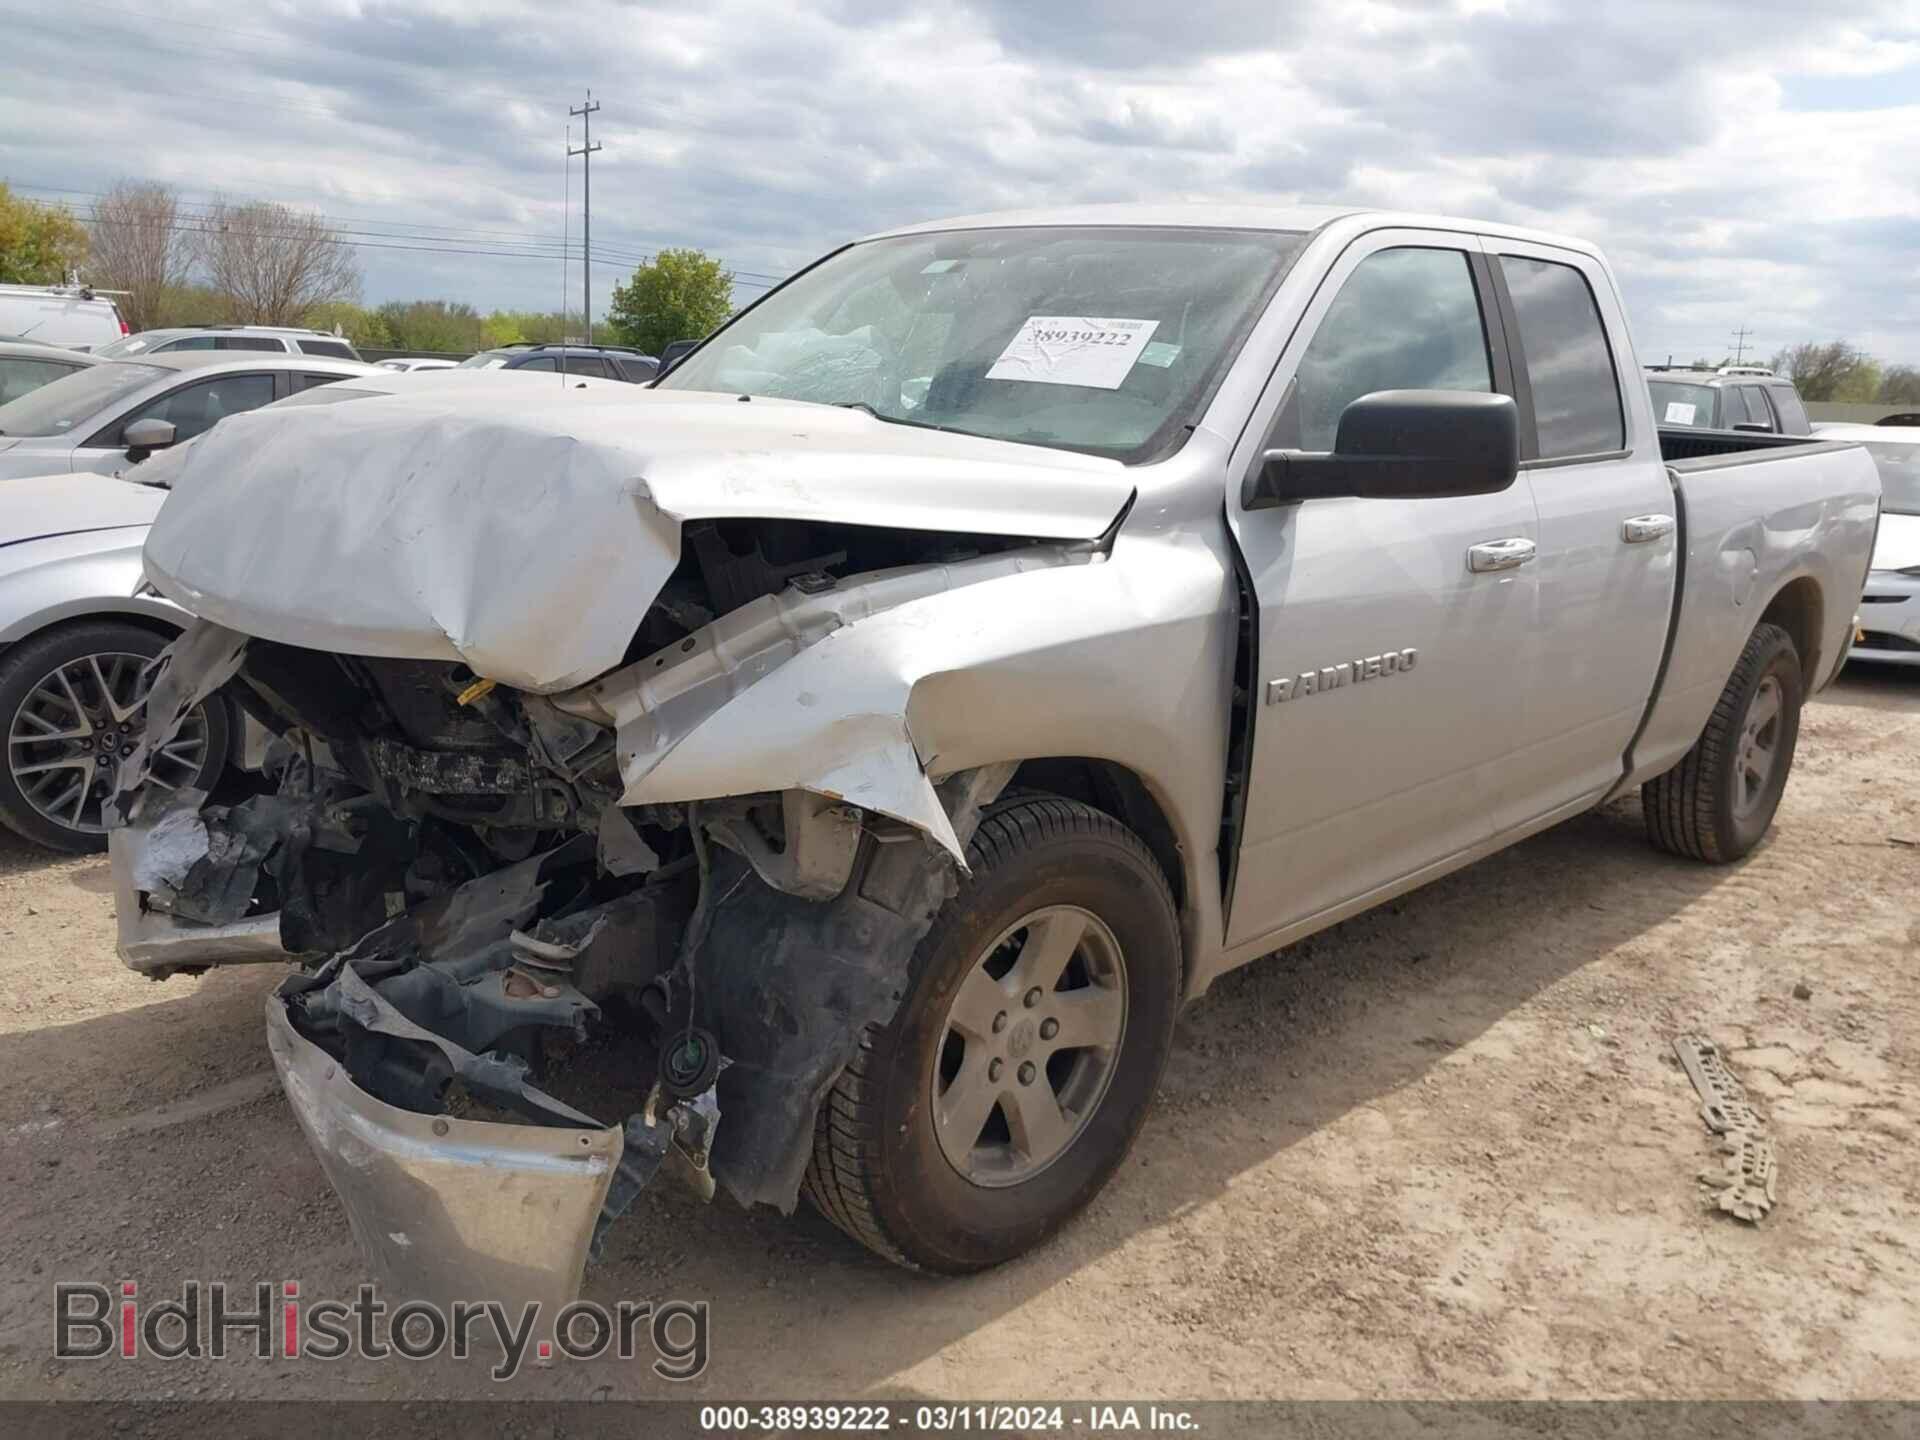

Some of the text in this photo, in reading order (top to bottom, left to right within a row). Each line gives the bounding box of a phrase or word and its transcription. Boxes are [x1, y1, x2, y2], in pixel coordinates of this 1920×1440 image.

[1027, 330, 1132, 346] 38939222
[1266, 648, 1418, 705] RAM 1500
